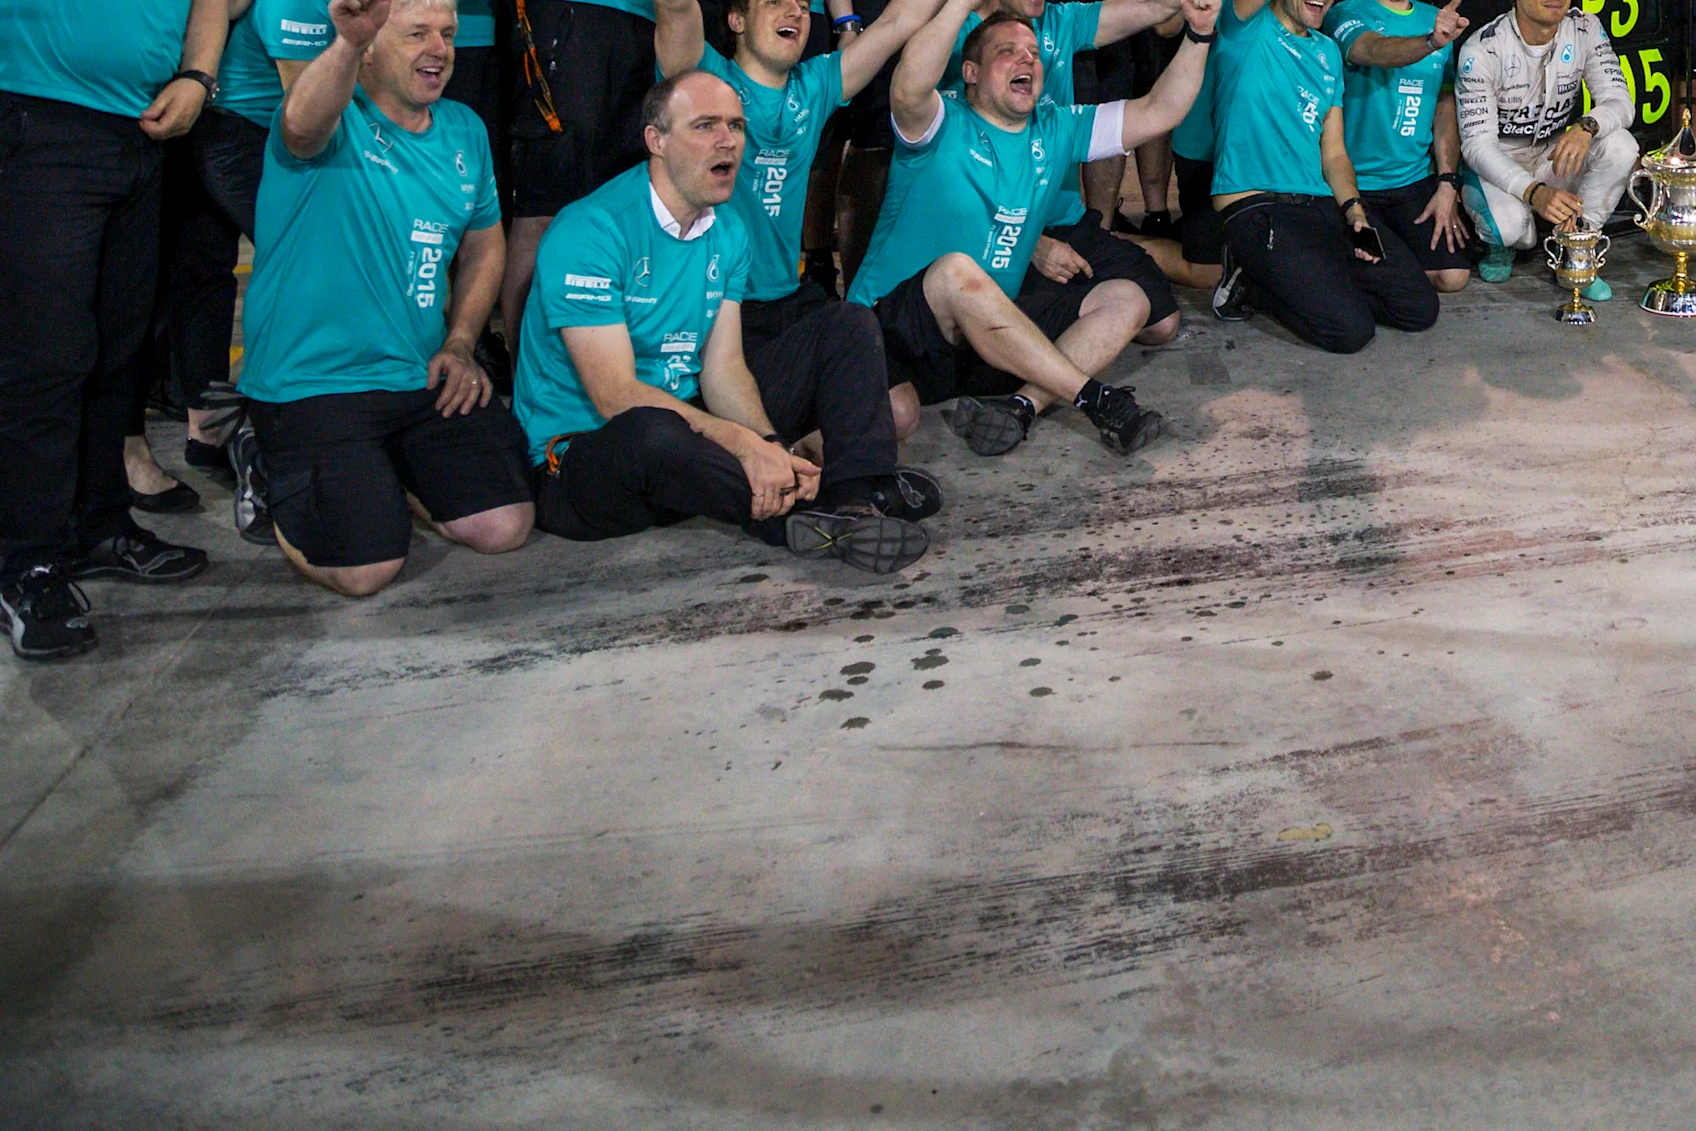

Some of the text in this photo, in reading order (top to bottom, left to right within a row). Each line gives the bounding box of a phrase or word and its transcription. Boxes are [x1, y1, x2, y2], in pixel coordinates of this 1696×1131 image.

[1399, 78, 1424, 87] RACE
[1400, 96, 1422, 137] 2015
[1460, 107, 1489, 120] EPSON
[758, 148, 791, 158] RACE
[762, 166, 788, 217] 2015
[998, 205, 1028, 216] RACE
[413, 218, 448, 234] RACE
[991, 225, 1022, 269] 2015
[416, 248, 443, 309] 2015
[663, 331, 698, 343] RACE
